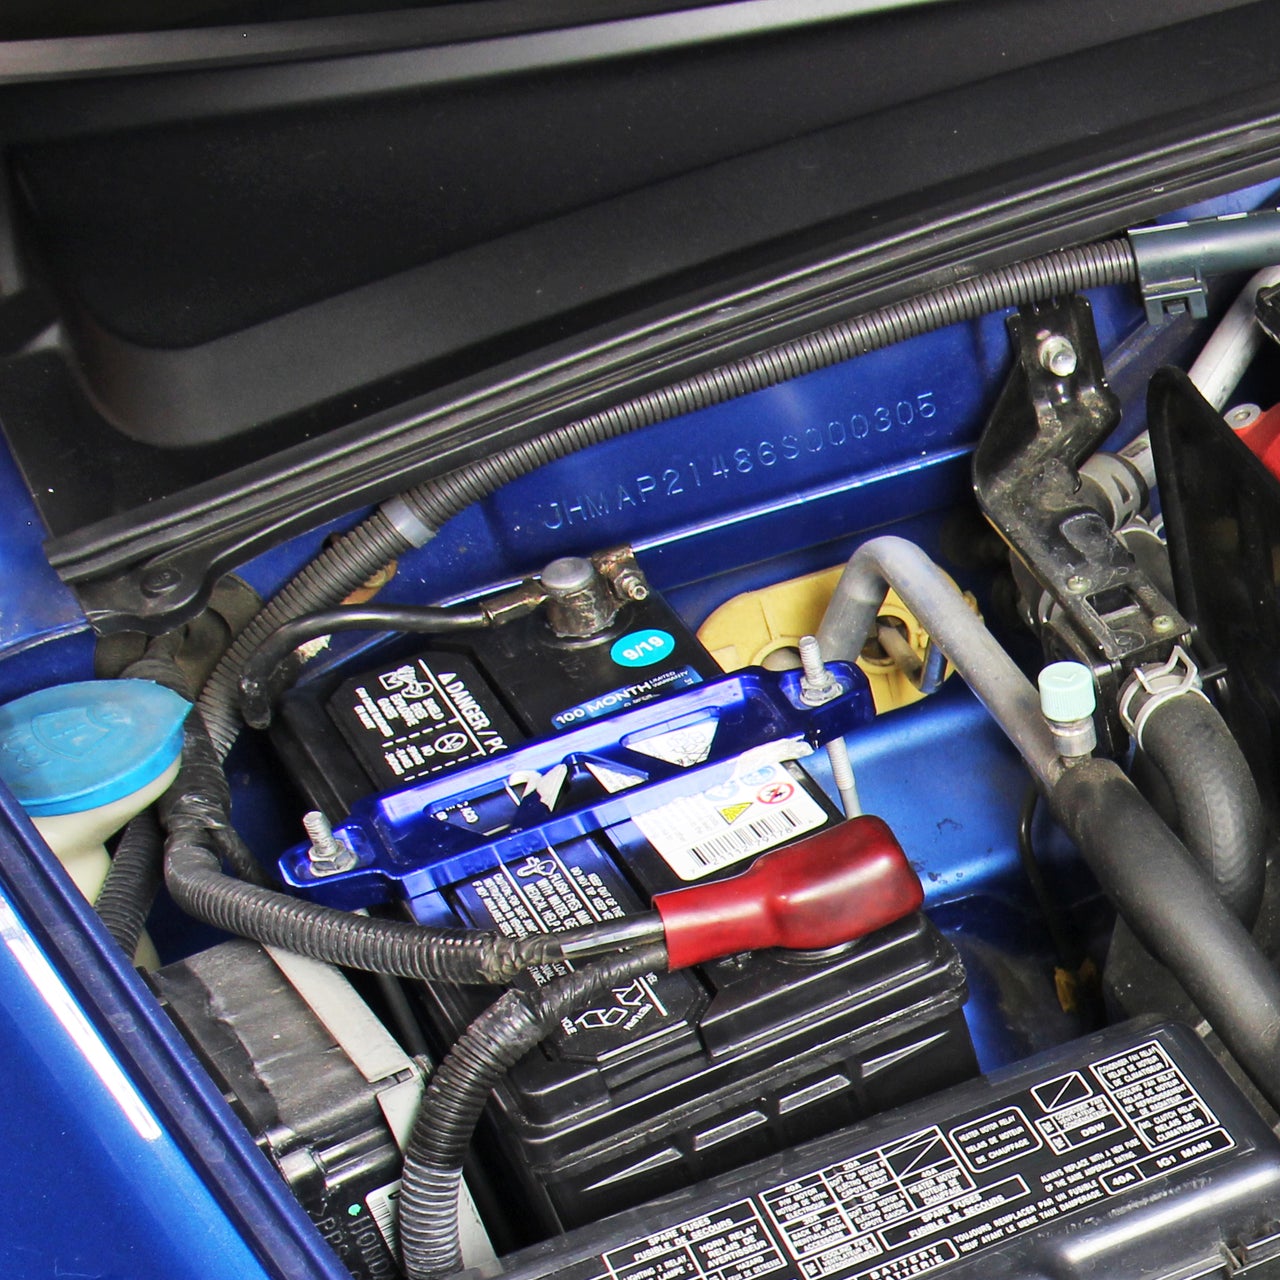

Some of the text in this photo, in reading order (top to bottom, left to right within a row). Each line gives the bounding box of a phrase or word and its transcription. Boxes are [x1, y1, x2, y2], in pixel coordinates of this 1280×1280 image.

[622, 636, 665, 661] 9/19
[445, 681, 490, 731] DANGER
[556, 681, 652, 724] 100 MONTH
[536, 878, 555, 896] WITH
[570, 866, 582, 876] DO
[576, 875, 591, 887] NOT
[476, 886, 489, 897] NOT
[548, 873, 582, 911] FLUSH EYES
[597, 886, 611, 898] OUT
[605, 898, 617, 906] OF
[508, 895, 520, 907] FOR
[514, 905, 529, 919] SAFE
[523, 883, 561, 926] MEDICAL HELP
[1143, 1072, 1176, 1088] FAN RELAY
[1154, 1079, 1180, 1092] MOTEUR
[998, 1115, 1015, 1126] RELAY
[1153, 1111, 1177, 1124] CLUTCH
[1154, 1118, 1182, 1133] RELAIS
[1081, 1122, 1105, 1137] DBW
[1156, 1119, 1204, 1142] CLIMATISEUR
[988, 1138, 1030, 1159] CHAUFFAGE
[921, 1168, 938, 1178] 40A
[1040, 1144, 1125, 1183] ALWAYS REPLACE NEW
[1112, 1141, 1212, 1185] 40A IG1 MAIN
[844, 1172, 857, 1180] TOP
[909, 1169, 961, 1194] HEATER MOTOR
[1054, 1179, 1067, 1187] THE
[785, 1183, 802, 1193] 40A
[793, 1188, 818, 1201] MOTOR
[924, 1184, 963, 1205] CHAUFFAGE
[863, 1203, 876, 1212] TOP
[908, 1195, 1005, 1238] FUSIBLE DE SECOURS
[919, 1193, 982, 1222] SPARE FUSES
[953, 1180, 1099, 1243] TOUJOURS REMPLACER PAR FUSIBLE
[634, 1218, 733, 1262] FUSIBLE DE SECOURS
[648, 1217, 711, 1246] SPARE FUSES
[699, 1225, 757, 1253] HORN RELAY
[791, 1229, 811, 1240] BACK
[827, 1217, 841, 1227] ACC
[959, 1207, 1059, 1252] NEUF AYANT LE TAUX
[707, 1235, 756, 1258] RELAIS DE
[708, 1240, 767, 1268] AVERTISSEUR
[664, 1255, 687, 1269] RELAY
[736, 1256, 764, 1271] HAZARD
[870, 1247, 937, 1280] BATTERY
